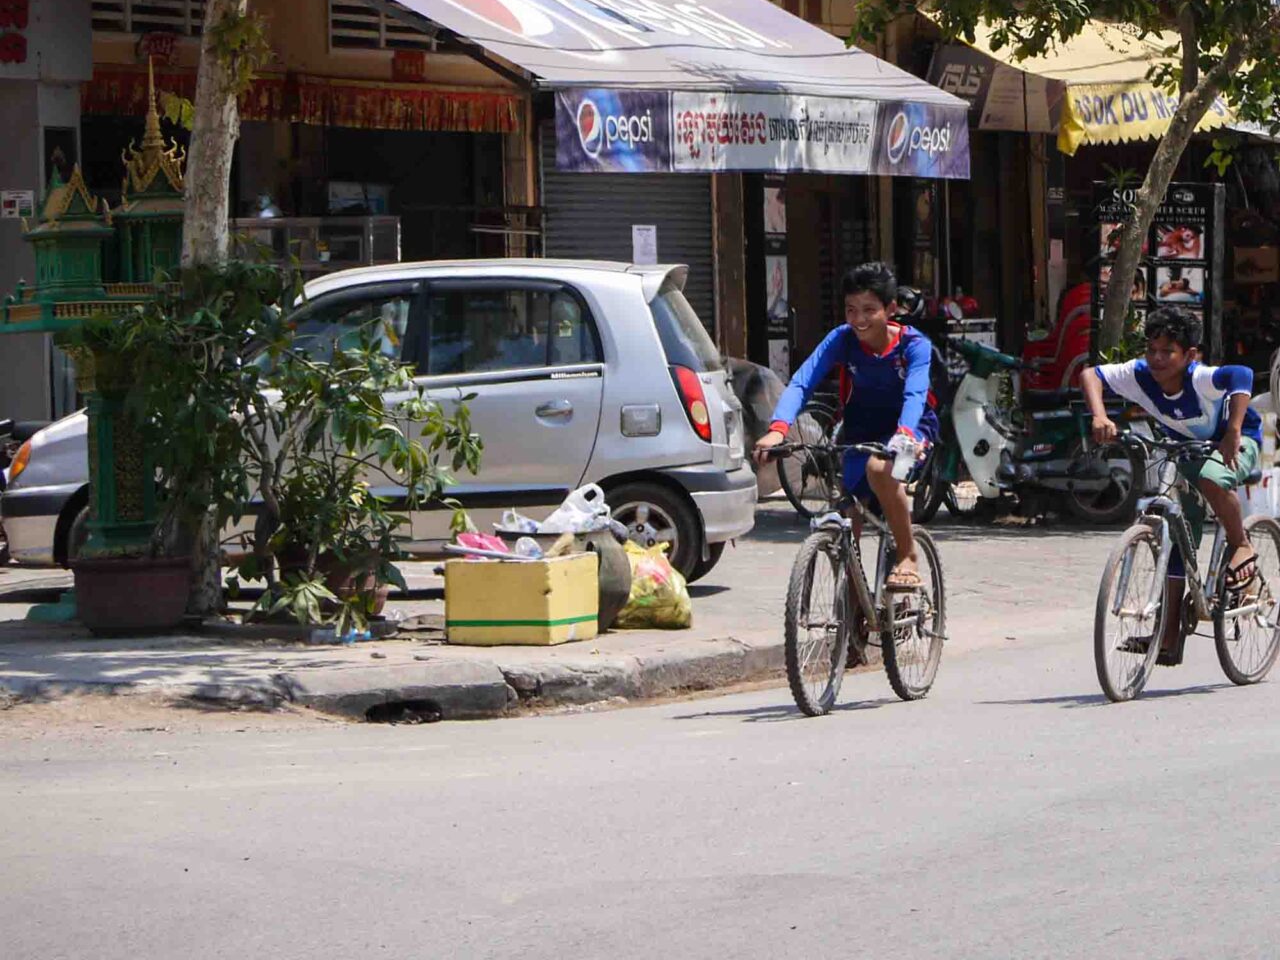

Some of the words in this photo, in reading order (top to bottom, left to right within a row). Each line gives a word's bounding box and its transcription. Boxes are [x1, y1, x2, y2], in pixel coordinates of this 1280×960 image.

[1120, 91, 1149, 122] DU
[605, 109, 653, 149] pepsi
[907, 122, 951, 157] pepsi
